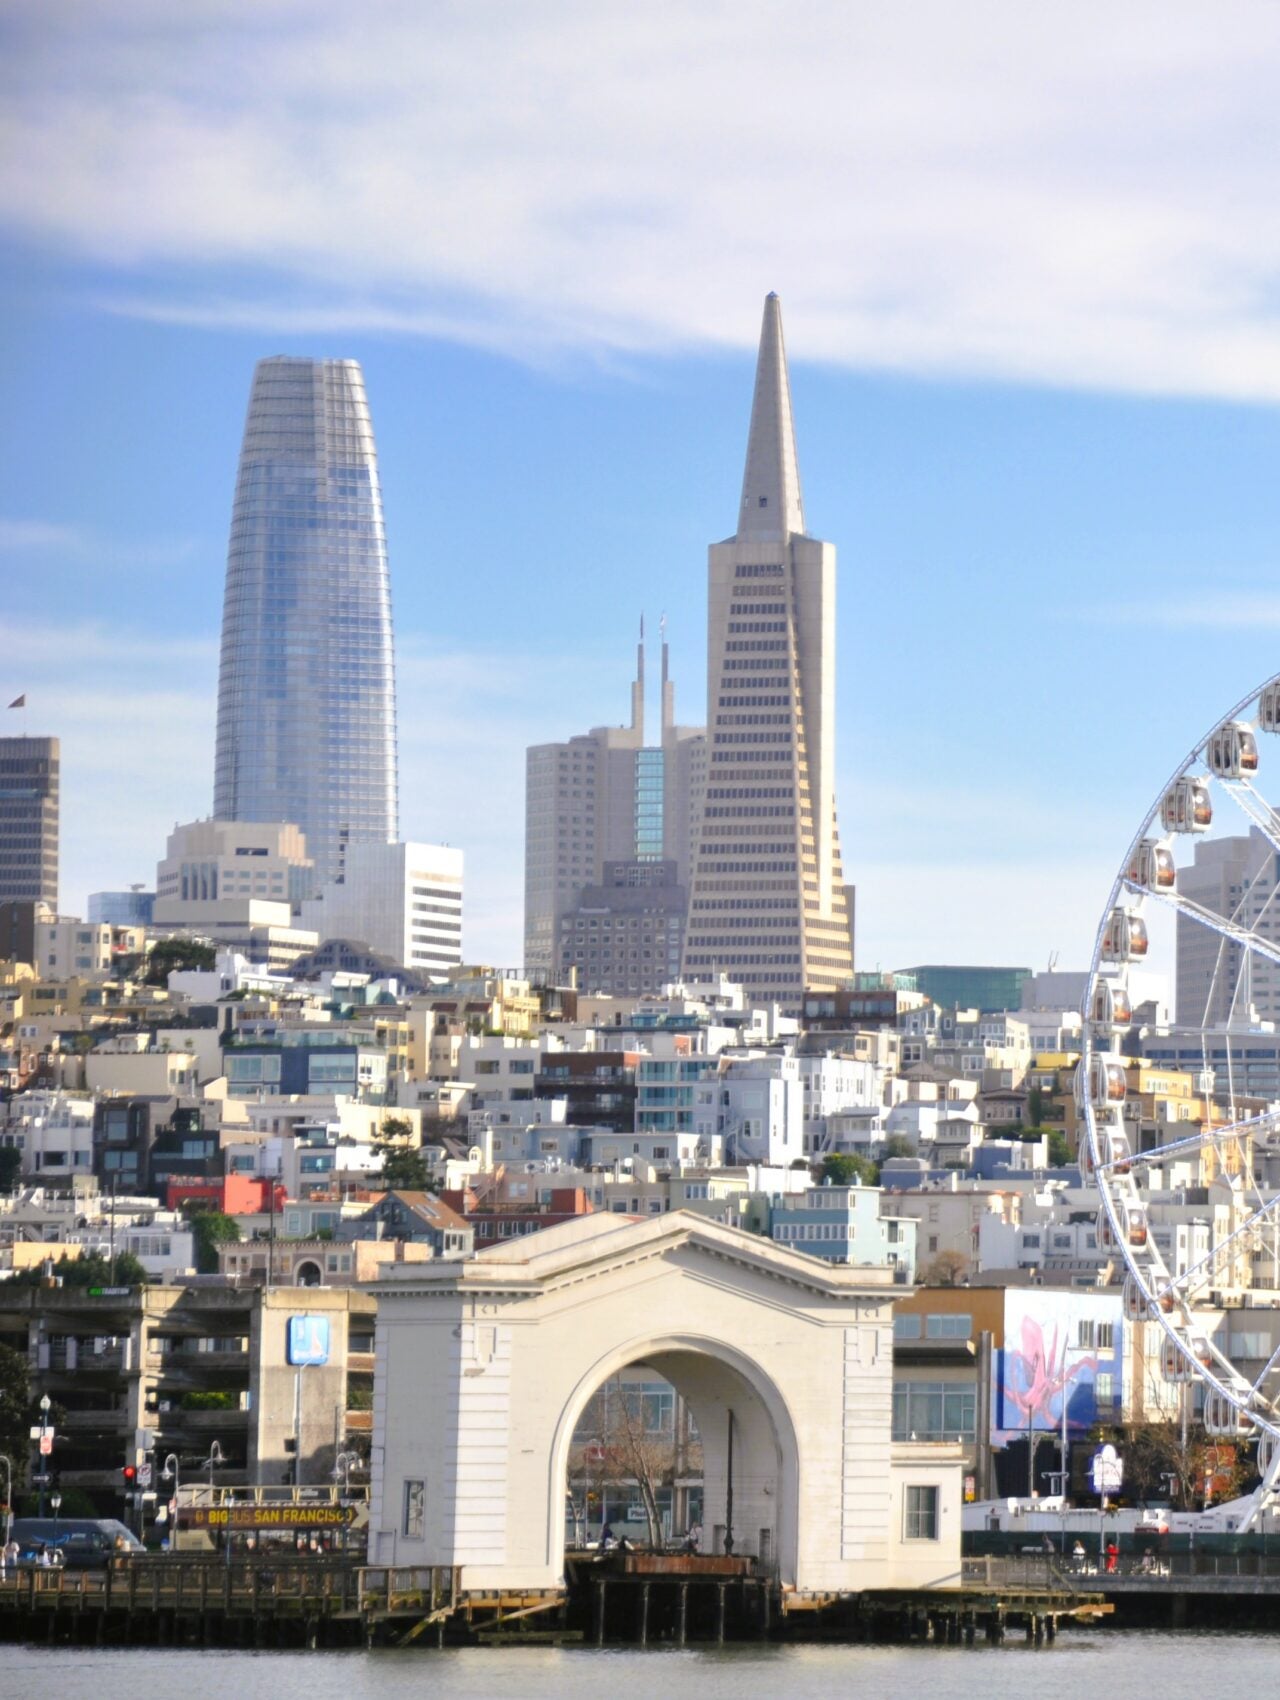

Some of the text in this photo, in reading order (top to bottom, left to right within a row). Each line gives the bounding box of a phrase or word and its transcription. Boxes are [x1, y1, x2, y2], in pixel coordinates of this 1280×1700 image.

[208, 1509, 229, 1524] BIG
[254, 1509, 280, 1523] SAN
[282, 1508, 353, 1523] FRANCISCO
